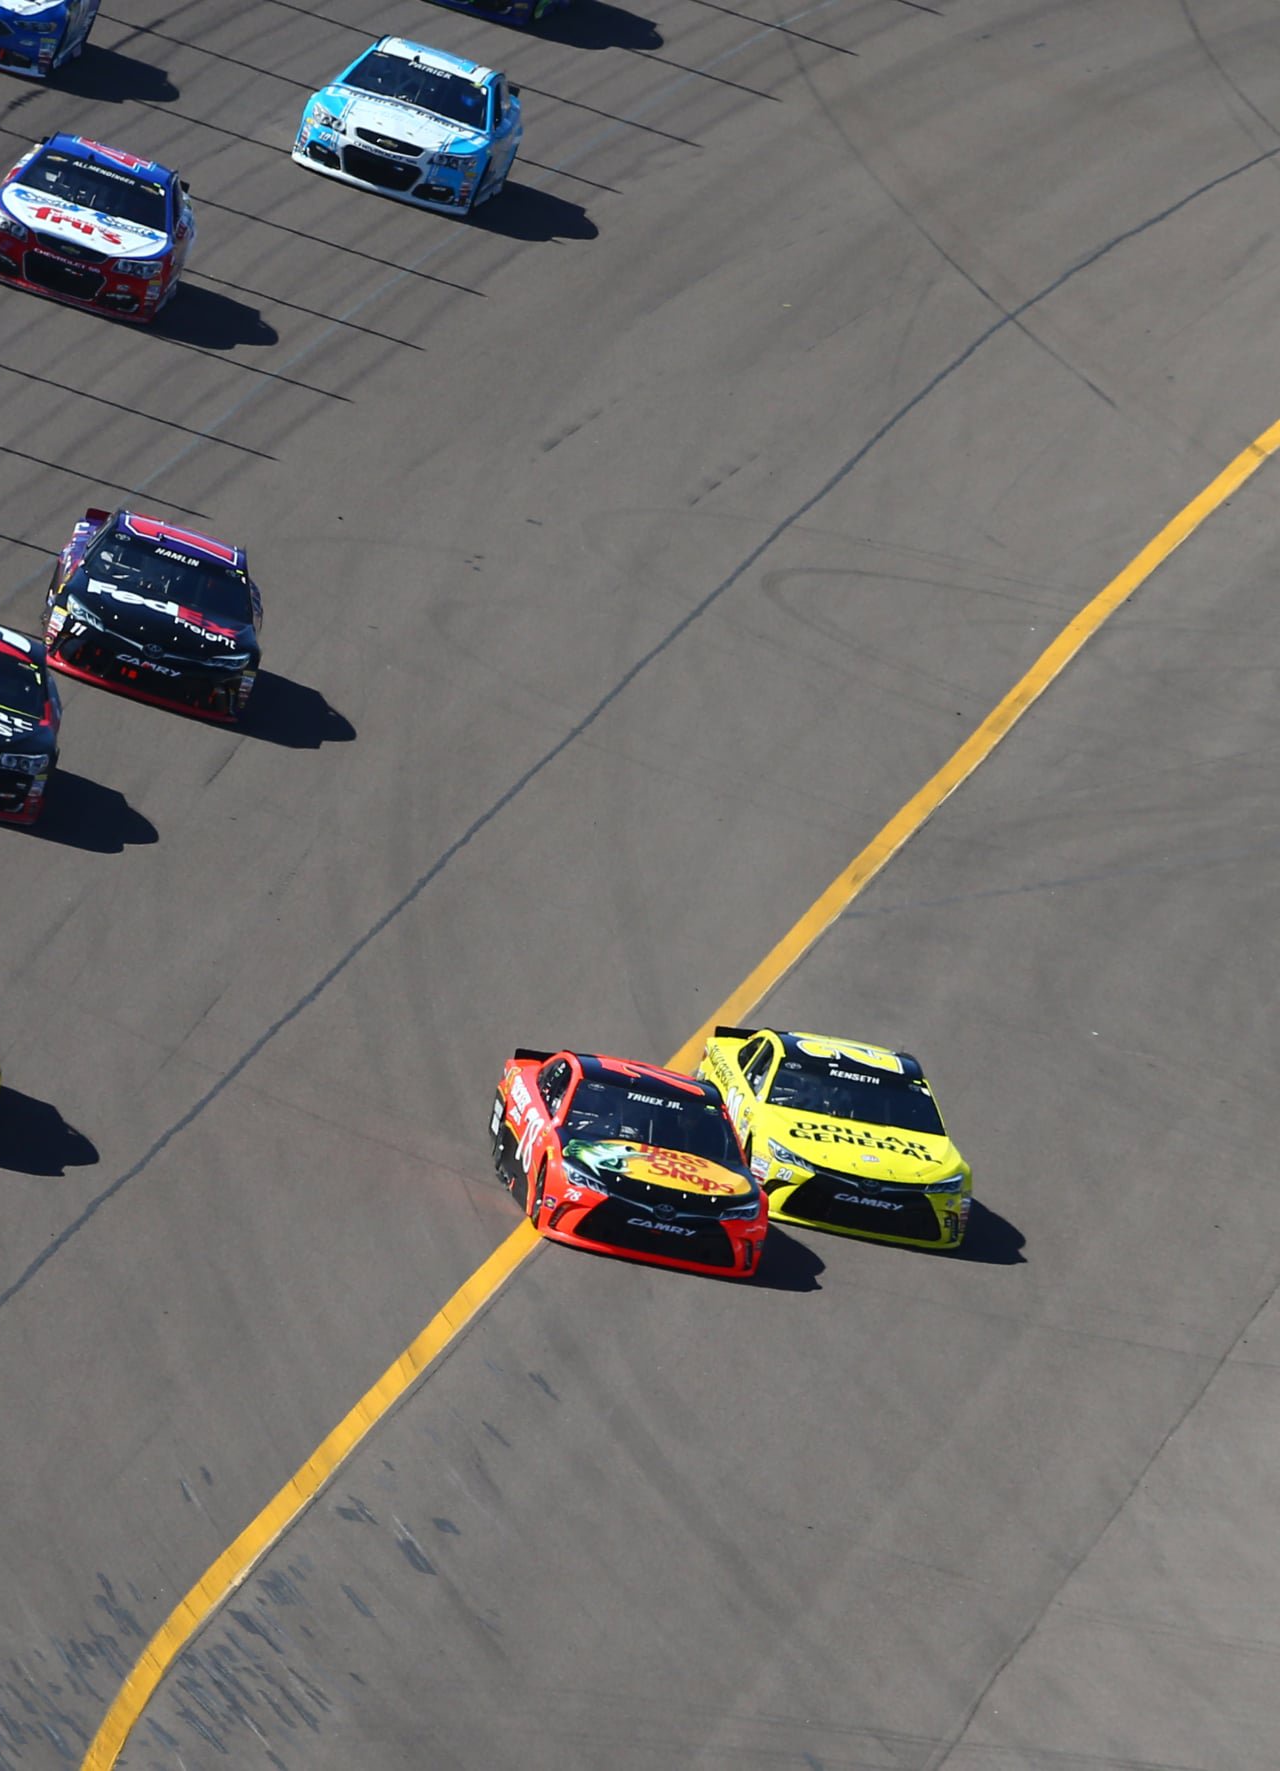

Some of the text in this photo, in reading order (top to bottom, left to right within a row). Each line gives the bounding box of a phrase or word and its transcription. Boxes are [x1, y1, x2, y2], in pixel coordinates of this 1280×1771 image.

[408, 61, 452, 79] PATRICK
[73, 160, 135, 185] ALLMENDINGER
[155, 547, 200, 568] HAMLIN
[87, 578, 239, 638] FedEx
[70, 622, 87, 636] 11
[175, 616, 236, 650] Freight
[116, 653, 182, 678] CAMRY
[830, 1068, 880, 1085] KENSETH
[627, 1091, 684, 1111] TRUEX JR.
[789, 1129, 943, 1165] GENERAL
[794, 1121, 930, 1153] DOLLAR
[648, 1162, 735, 1194] Shops
[776, 1168, 793, 1181] 20
[564, 1188, 581, 1202] 78
[834, 1193, 904, 1211] CAMRY
[626, 1217, 697, 1237] CAMRY
